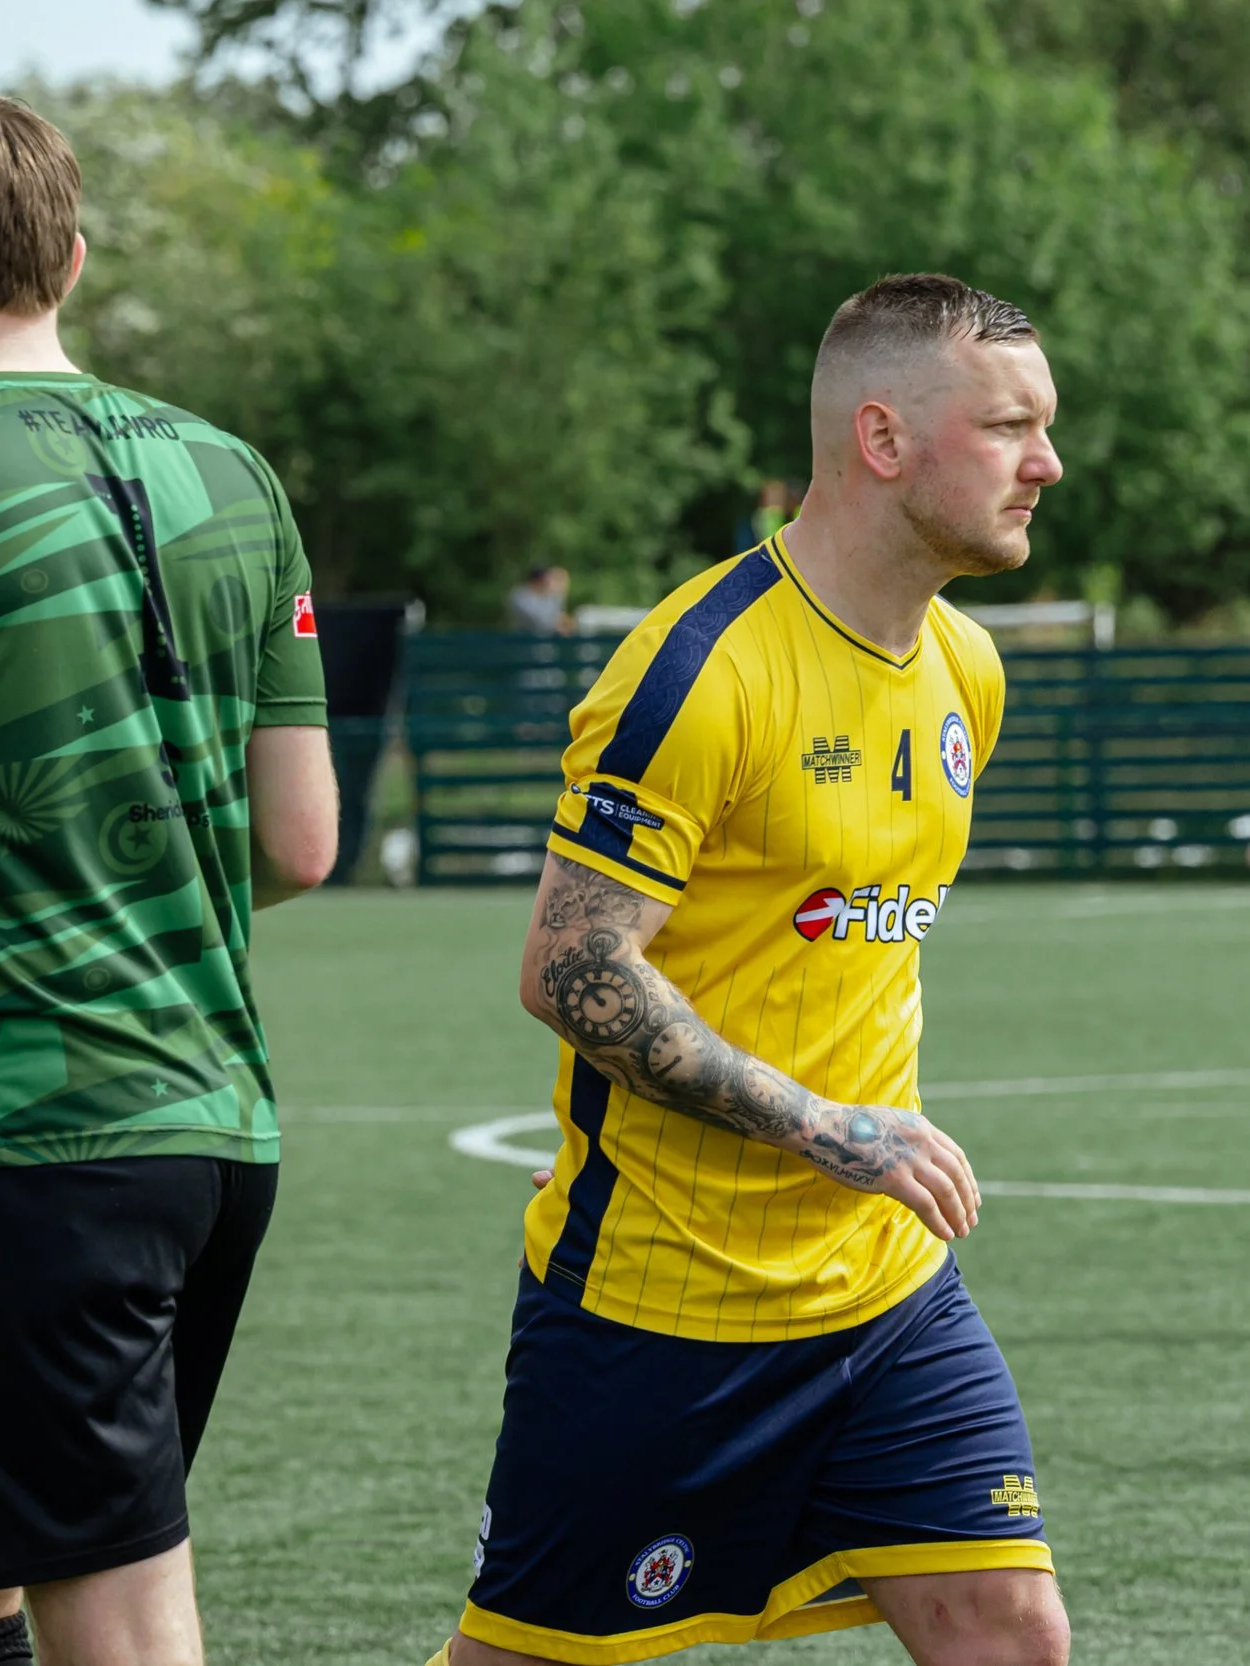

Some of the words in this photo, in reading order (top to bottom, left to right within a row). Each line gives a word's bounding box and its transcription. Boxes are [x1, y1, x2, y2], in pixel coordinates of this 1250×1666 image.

[18, 409, 180, 441] #TEAAVRO
[803, 752, 860, 767] MATCHWINNER
[891, 728, 912, 802] 4
[618, 811, 662, 829] EQUIPMENT
